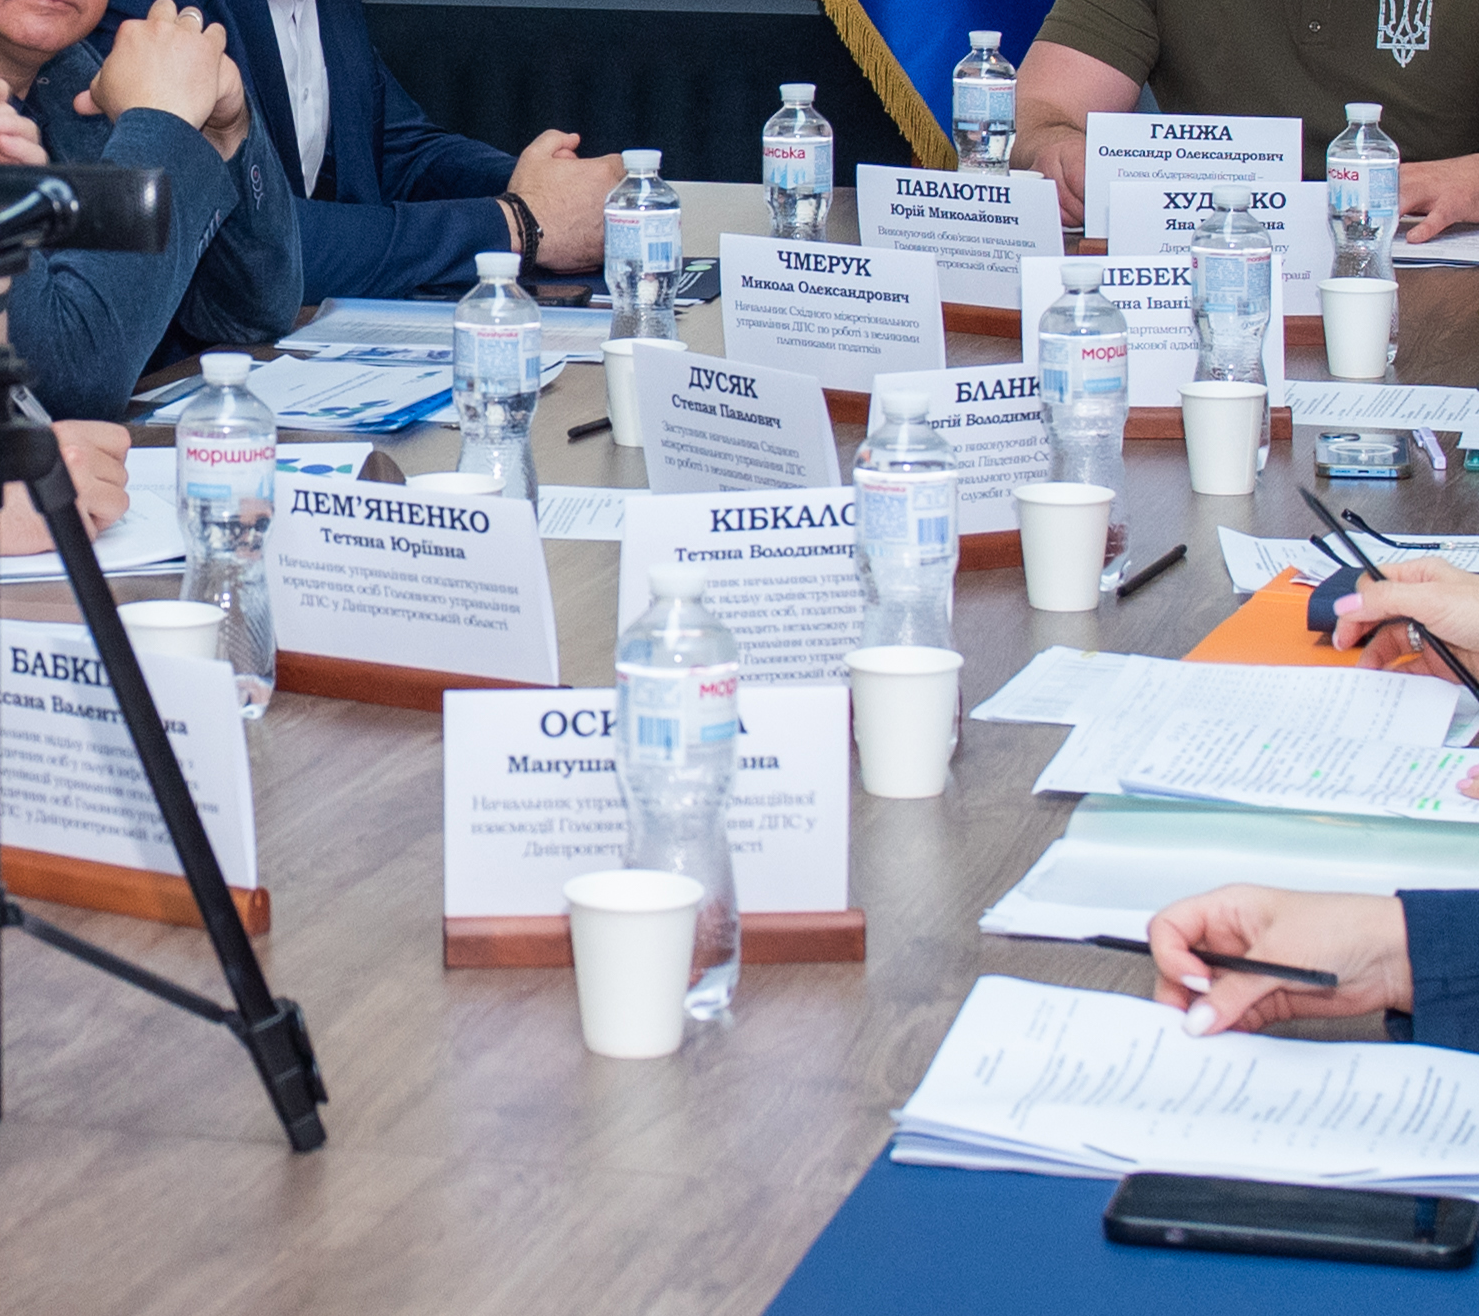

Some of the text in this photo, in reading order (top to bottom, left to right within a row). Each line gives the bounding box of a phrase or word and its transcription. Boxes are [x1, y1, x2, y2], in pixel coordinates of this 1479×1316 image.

[1150, 124, 1233, 141] ГАНЖА
[1099, 146, 1283, 163] Олександр Олександрович
[1118, 169, 1255, 182] Голова облдержадміністрації
[896, 178, 1011, 204] ПАВЛЮТІН
[1163, 191, 1287, 211] ХУДКО
[891, 203, 1019, 225] Юрій Миколайович
[1165, 219, 1195, 230] Яна
[777, 250, 872, 277] ЧМЕРУК
[992, 250, 1014, 260] ДПС
[936, 259, 985, 273] етровській
[741, 275, 910, 304] Микола Олександрович
[735, 300, 920, 329] Начальник Східного міжрегіонального
[736, 317, 791, 332] управління
[792, 321, 815, 334] ДПС
[817, 325, 830, 334] по
[831, 326, 862, 339] роботі
[871, 332, 920, 344] великими
[776, 336, 882, 355] платниками податків
[688, 365, 759, 400] ДУСЯК
[672, 394, 782, 429] Степан Павлович
[927, 411, 1044, 430] ргій Володими
[978, 451, 1050, 468] Південно-Сх
[785, 462, 807, 477] ДПС
[320, 528, 466, 560] Тетяна Юріївна
[675, 547, 743, 562] Тетяна
[300, 593, 330, 609] ДПС
